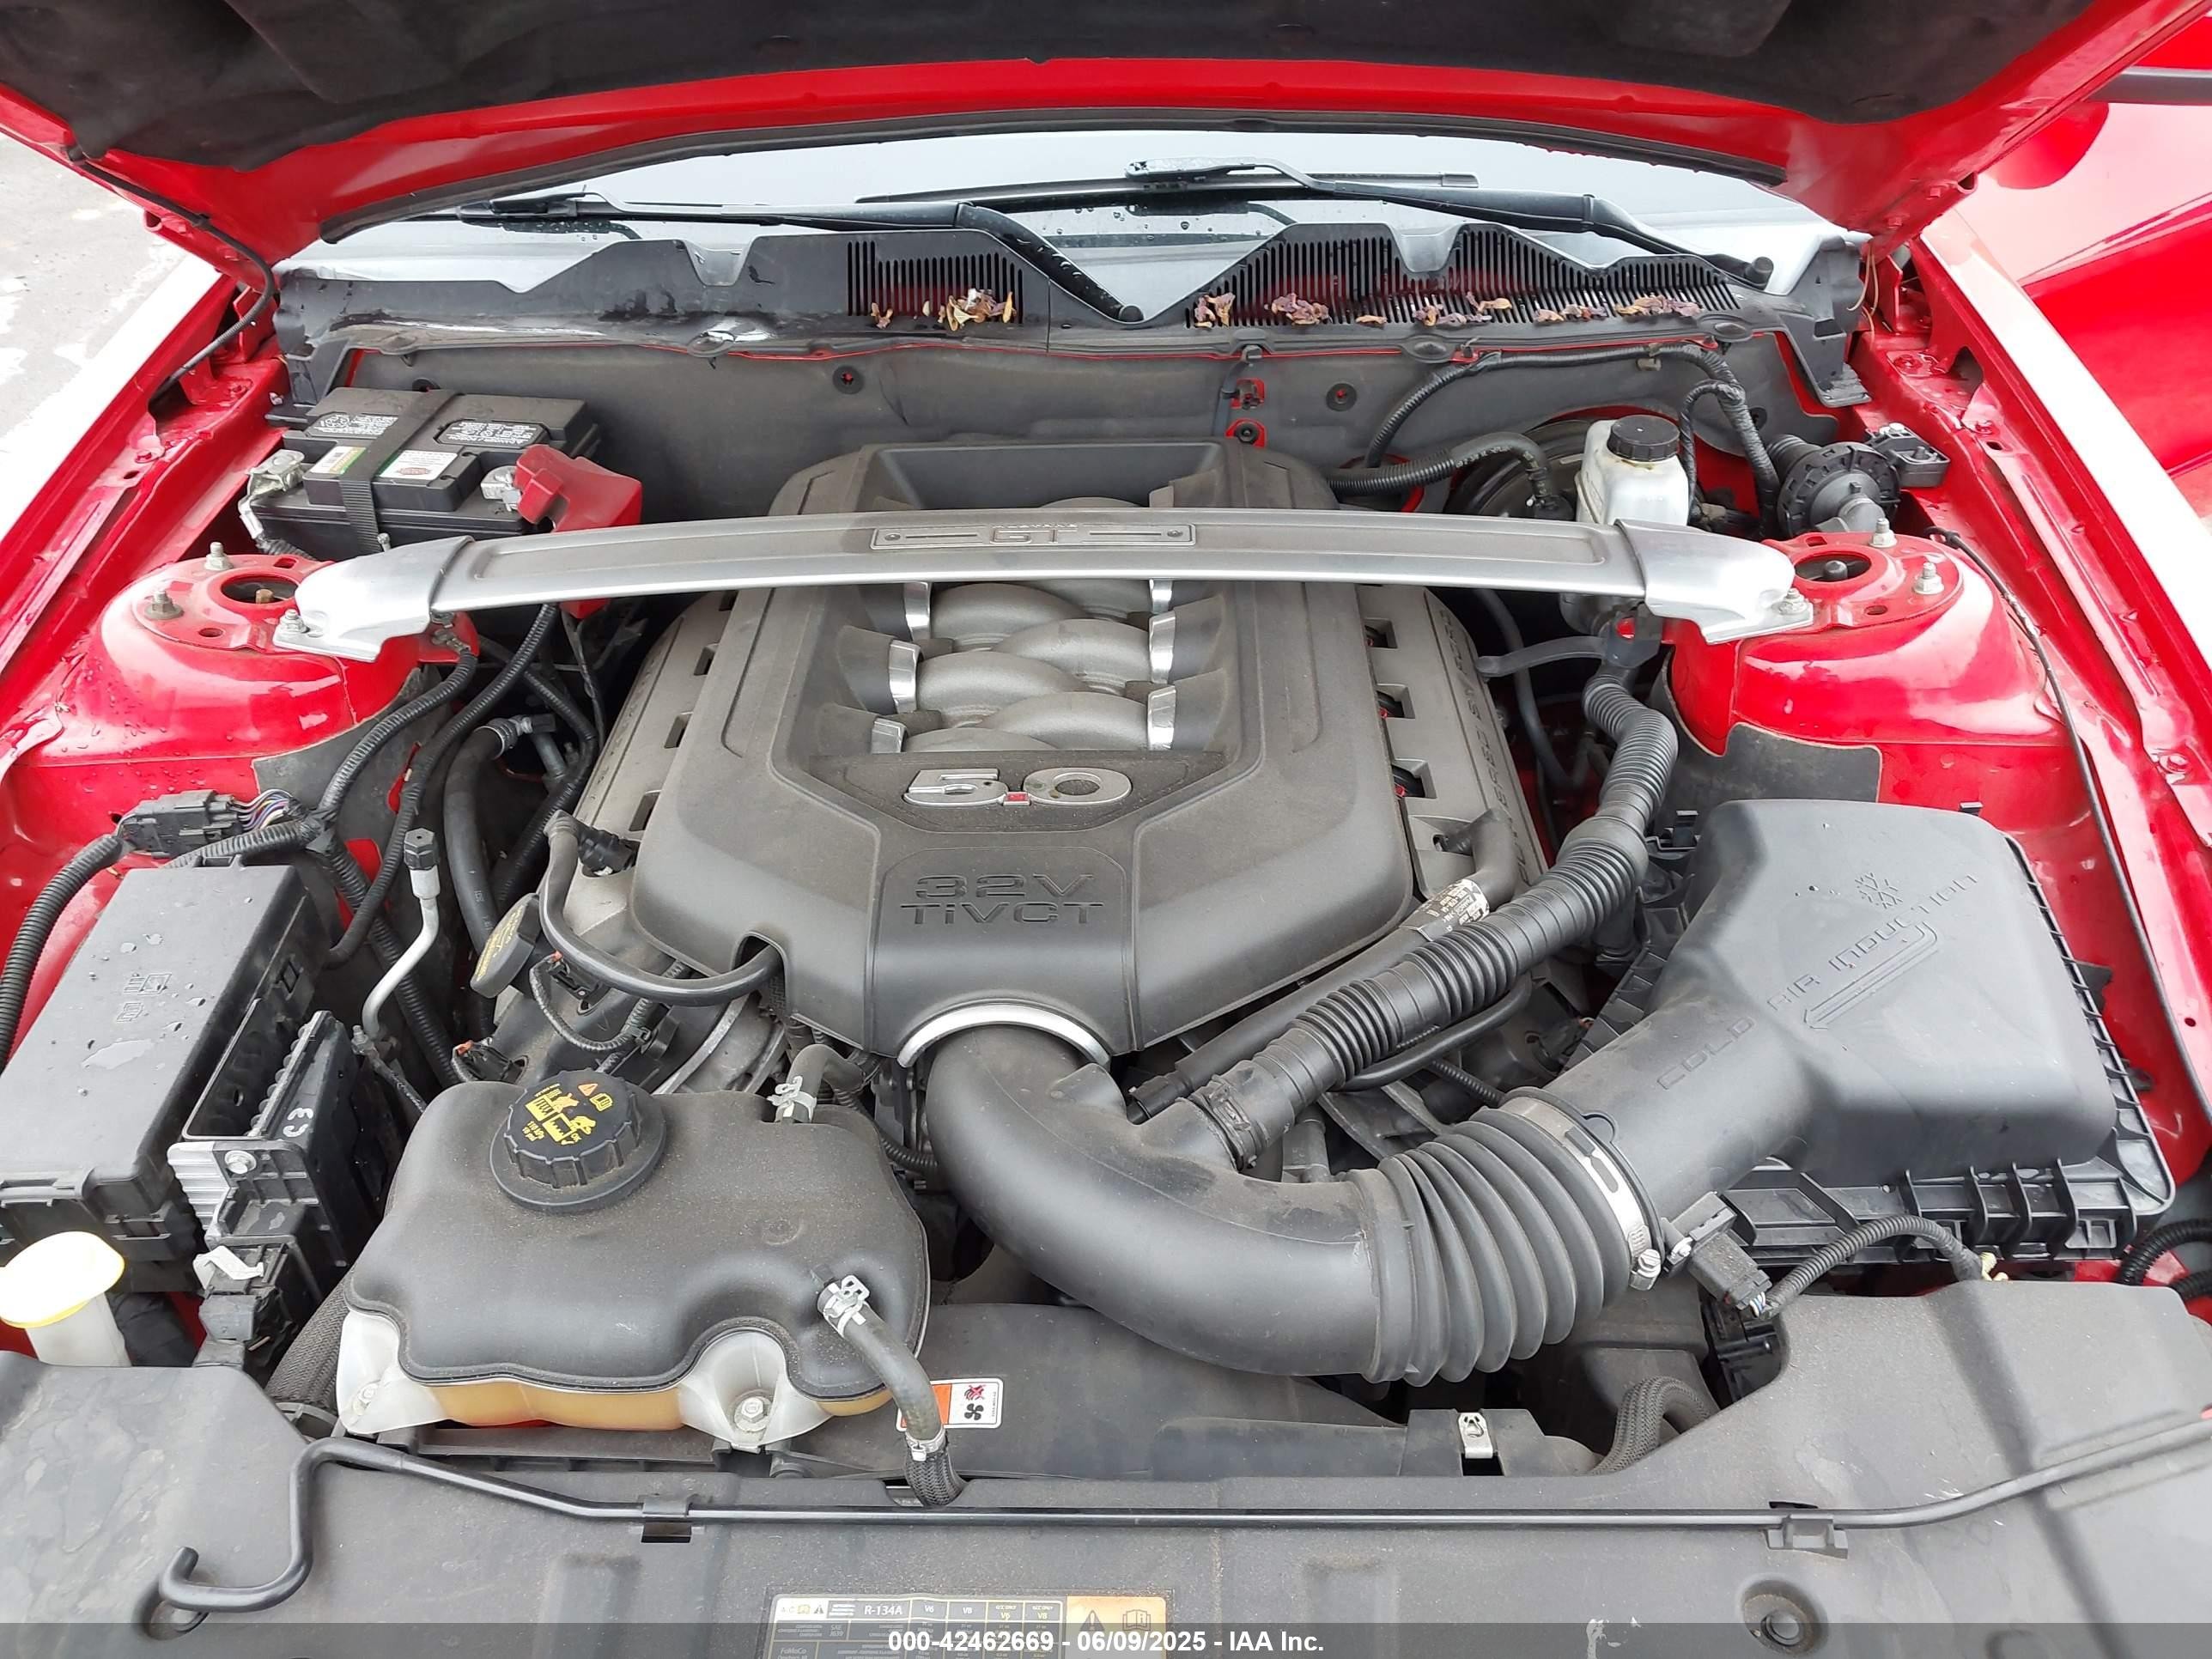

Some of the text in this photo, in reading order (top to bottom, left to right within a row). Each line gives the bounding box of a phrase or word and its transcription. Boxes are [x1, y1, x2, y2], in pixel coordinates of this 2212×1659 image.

[903, 767, 1133, 807] 5.0
[915, 873, 1095, 898] 32V
[1656, 1015, 1757, 1091] COLD
[1765, 973, 1822, 1012] AIR
[864, 1604, 903, 1615] R-134A
[924, 1605, 934, 1613] V6
